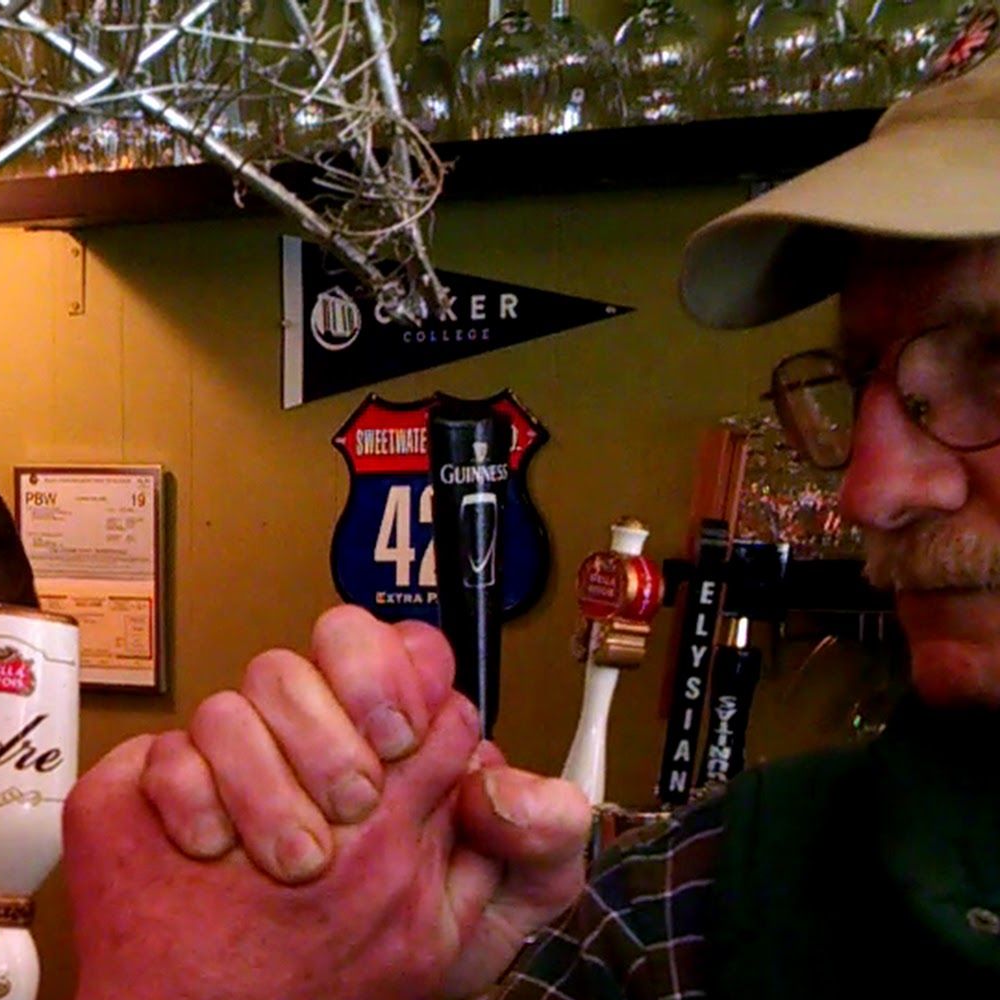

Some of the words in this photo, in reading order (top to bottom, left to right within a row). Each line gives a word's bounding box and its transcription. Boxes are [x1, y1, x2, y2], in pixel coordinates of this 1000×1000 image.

[374, 293, 519, 324] CKER
[402, 328, 490, 343] COLLEGE
[355, 428, 428, 456] SWEETWATE
[440, 463, 508, 485] GUINNESS
[25, 491, 57, 506] PBW
[373, 485, 438, 587] 42
[375, 591, 423, 604] EXTRA
[669, 581, 715, 793] ELYSIAN
